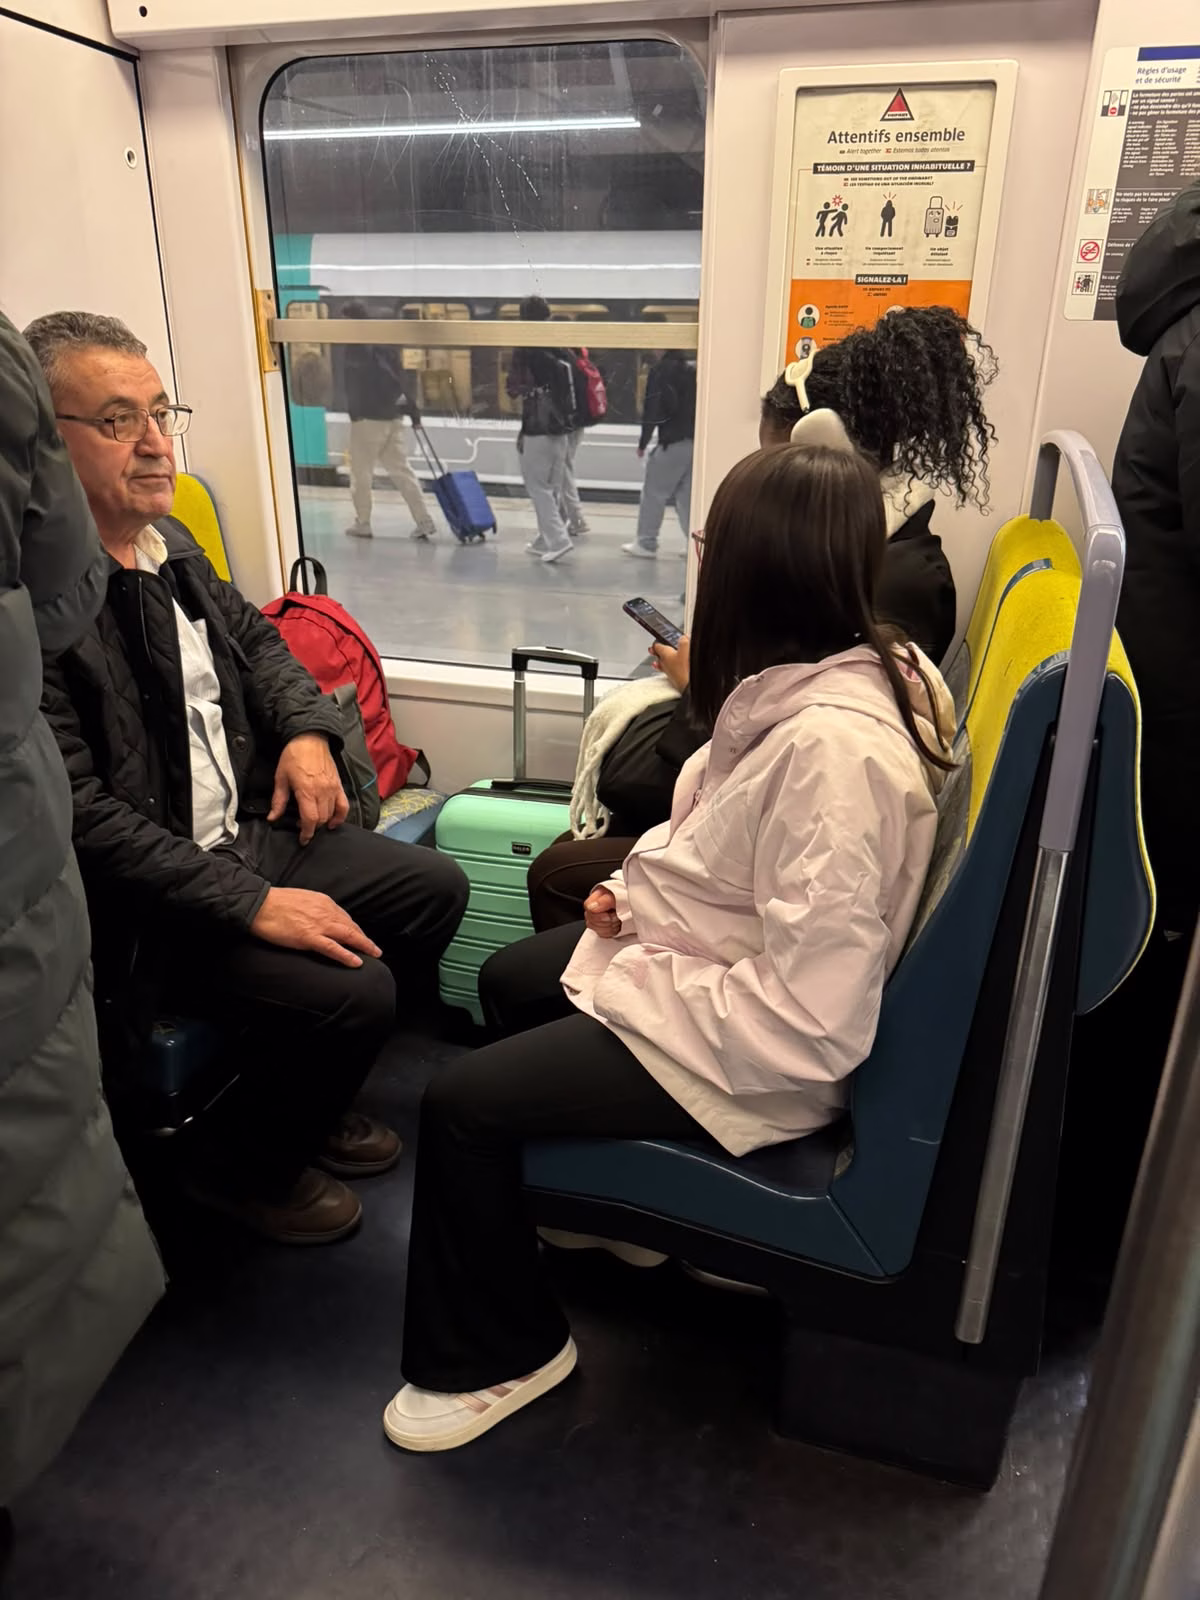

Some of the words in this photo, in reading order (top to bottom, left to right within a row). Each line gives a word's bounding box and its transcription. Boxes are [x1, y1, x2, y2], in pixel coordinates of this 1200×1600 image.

[1137, 67, 1159, 75] Règles
[1161, 66, 1187, 74] d'usage
[827, 129, 891, 144] Attentifs
[895, 127, 965, 142] ensemble
[817, 163, 845, 172] TÉMOIN
[871, 163, 910, 171] SITUATION
[911, 162, 965, 171] INHABITUELLE
